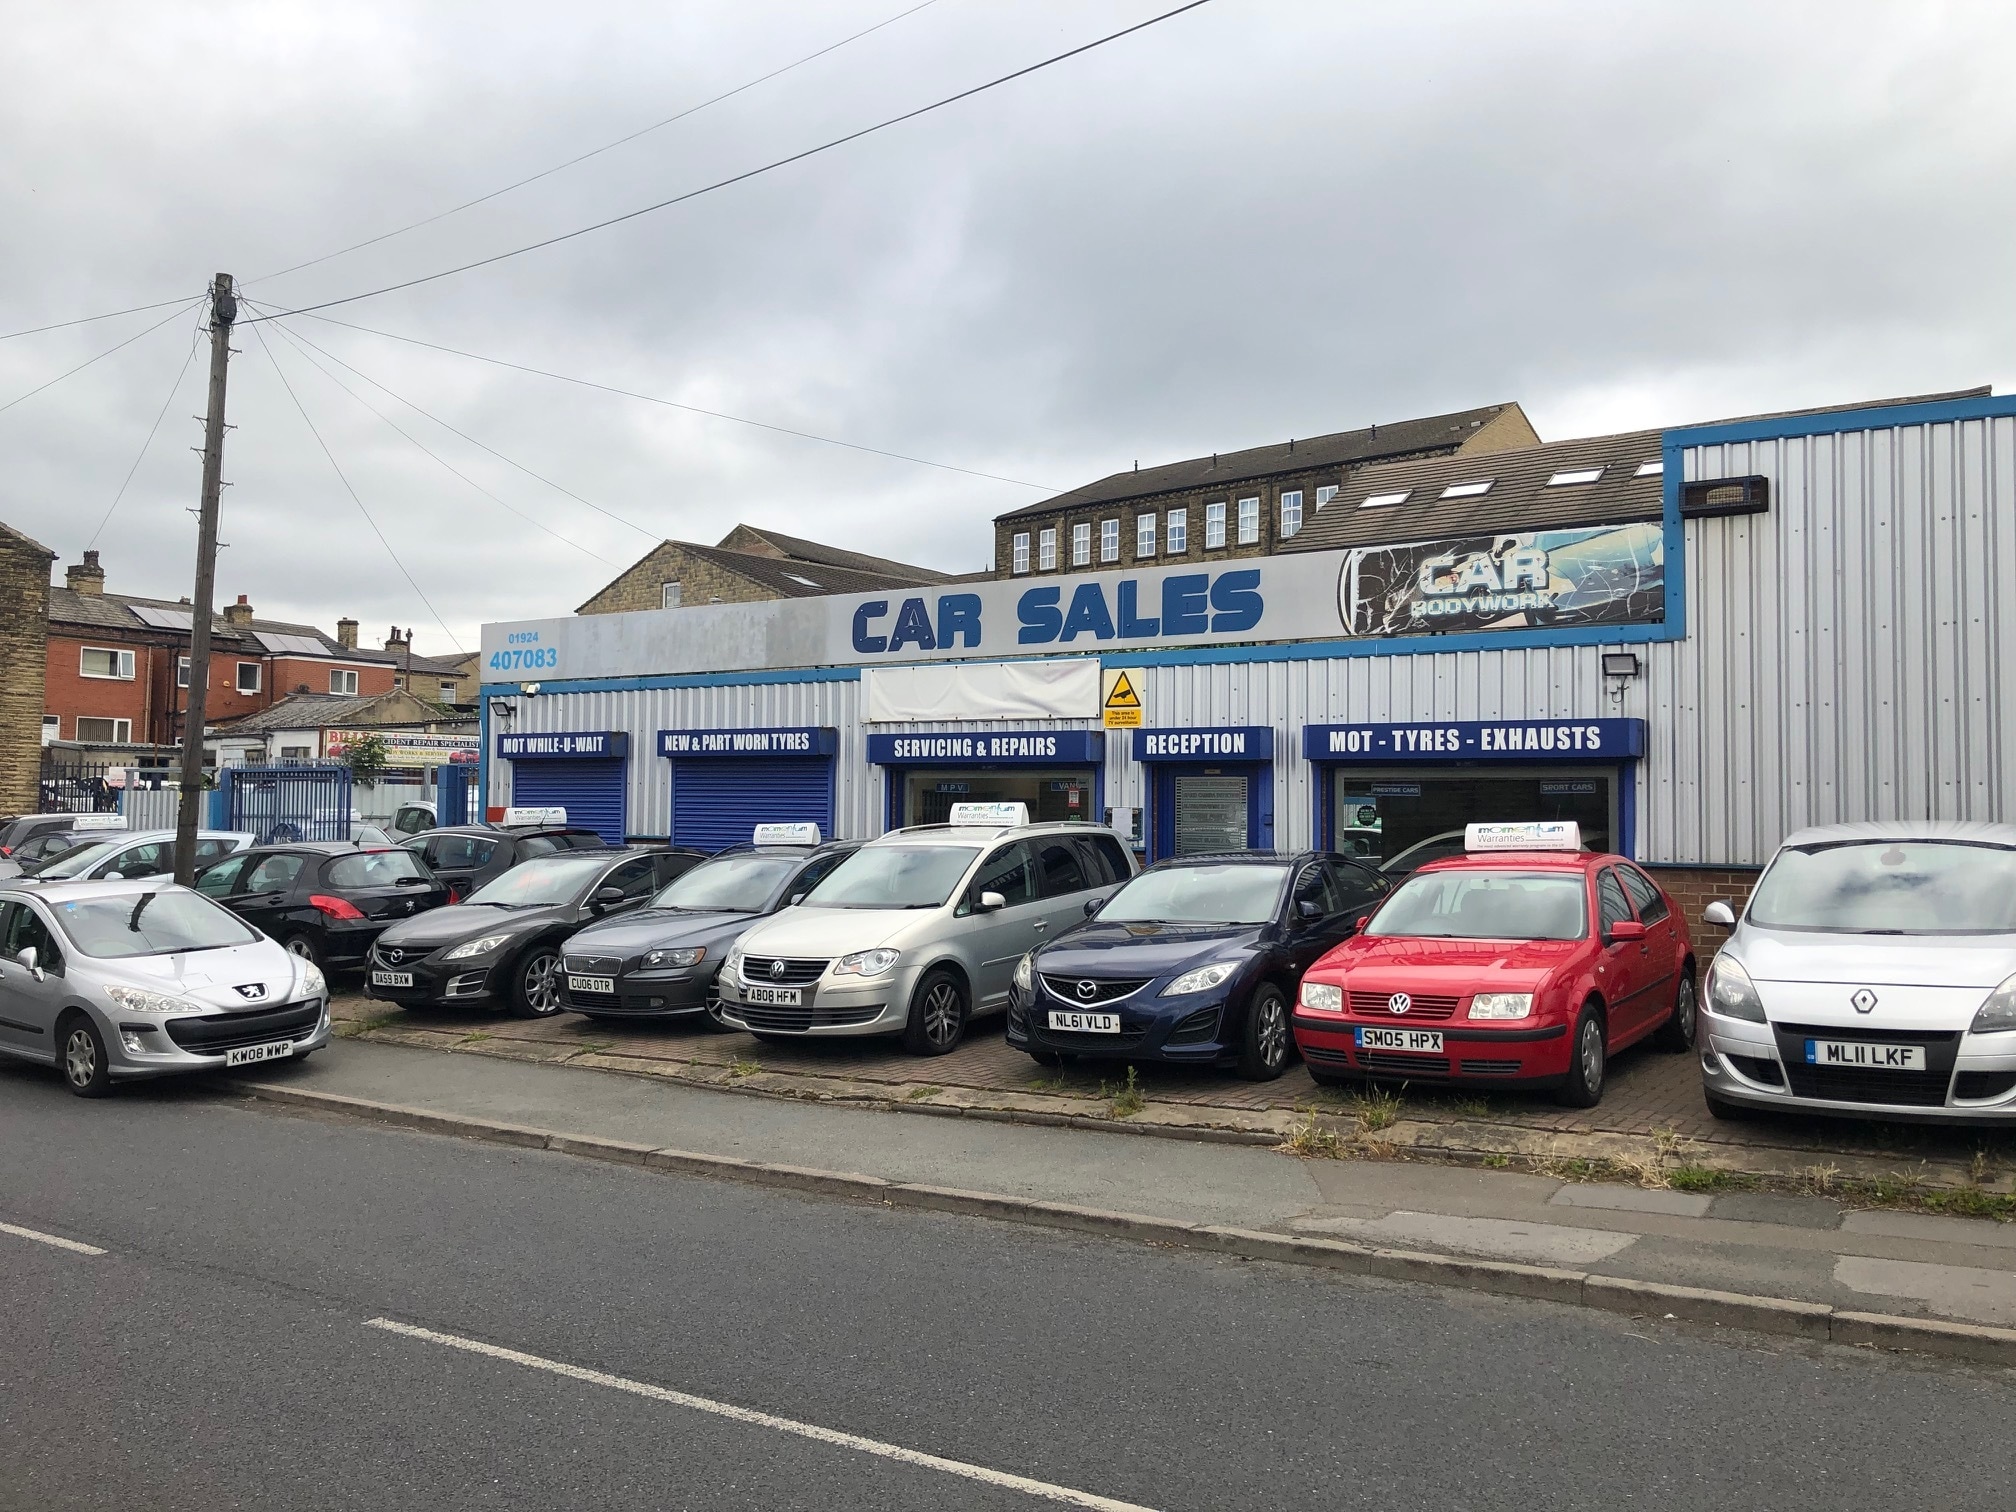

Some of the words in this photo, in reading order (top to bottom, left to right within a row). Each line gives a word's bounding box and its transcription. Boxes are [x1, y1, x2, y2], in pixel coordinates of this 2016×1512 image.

[1420, 550, 1549, 594] CAR
[852, 593, 982, 653] CAR
[1017, 569, 1264, 645] SALES
[1411, 593, 1556, 617] BODYWORK
[508, 632, 539, 644] 01924
[489, 648, 557, 670] 407083
[413, 739, 439, 747] REPAIR
[503, 738, 524, 753] MOT
[527, 736, 604, 753] WHILE-U-WAIT
[665, 735, 690, 751] NEW
[692, 737, 700, 751] &
[702, 734, 731, 751] PART
[733, 734, 768, 750] WORN
[771, 733, 809, 750] TYRES
[894, 738, 972, 757] SERVICING
[976, 741, 987, 756] &
[991, 737, 1056, 756] REPAIRS
[1146, 733, 1245, 754] RECEPTION
[1329, 730, 1373, 752] MOT
[1392, 728, 1460, 751] TYRES
[1481, 726, 1600, 750] EXHAUSTS
[958, 803, 1015, 815] momentum
[1477, 834, 1525, 842] Warranties
[1478, 823, 1564, 837] momentum
[375, 973, 392, 983] DA59
[394, 974, 409, 985] BXW
[571, 978, 592, 989] CU06
[593, 980, 611, 991] OTR
[751, 989, 774, 1001] AB08
[776, 990, 796, 1003] HFM
[1056, 1013, 1082, 1028] NL61
[1086, 1015, 1111, 1029] VLD
[1364, 1030, 1404, 1047] SM05
[1409, 1033, 1441, 1049] HPX
[232, 1048, 264, 1063] KW08
[267, 1043, 289, 1057] WWP
[1827, 1045, 1865, 1063] ML11
[1872, 1047, 1913, 1065] LKF
